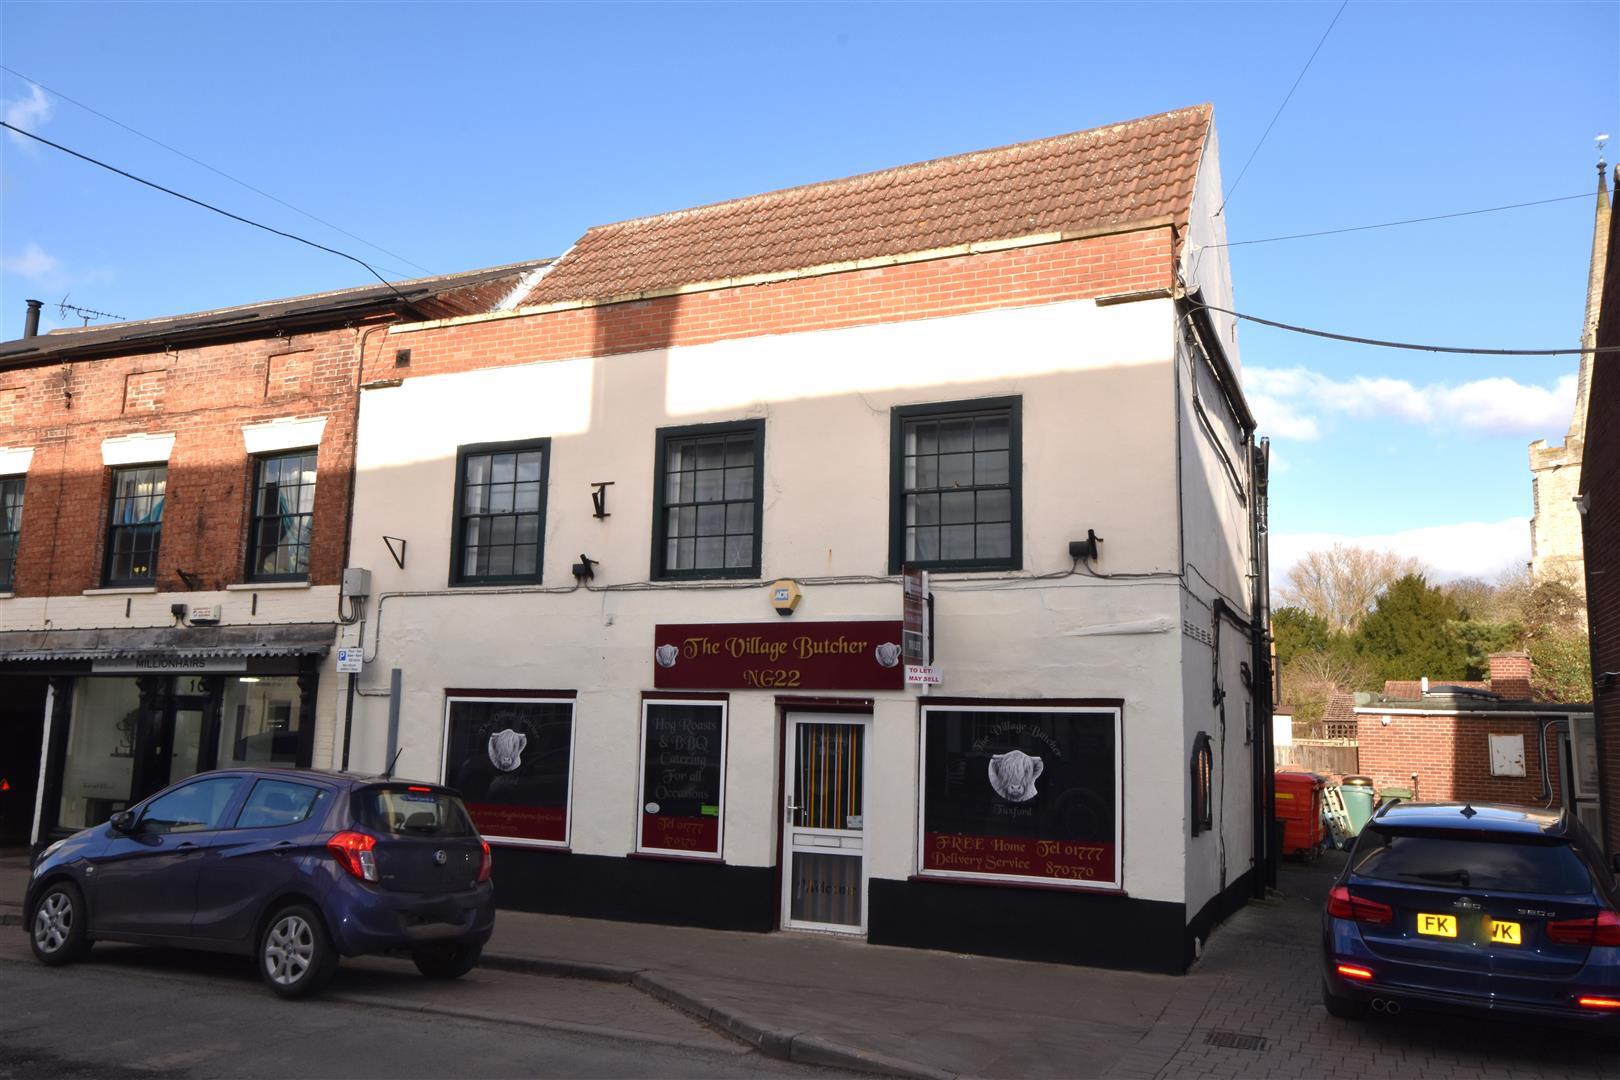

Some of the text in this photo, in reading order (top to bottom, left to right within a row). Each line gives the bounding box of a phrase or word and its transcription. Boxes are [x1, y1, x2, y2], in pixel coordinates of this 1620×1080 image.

[775, 590, 789, 599] ADT
[683, 636, 868, 662] The Village Butcher
[135, 658, 206, 669] MILLIONHAIRS
[743, 669, 801, 688] NG22
[653, 717, 717, 735] Hog Roasts
[658, 735, 709, 752] & BBQ
[972, 721, 1065, 758] The Village Butcher
[659, 753, 707, 769] Catering
[662, 770, 703, 784] For all
[935, 836, 1026, 853] FREE Home
[1036, 840, 1105, 861] Tel 01777
[932, 852, 1031, 870] Delivery Service
[1046, 861, 1094, 880] 870370
[1425, 916, 1449, 933] FK
